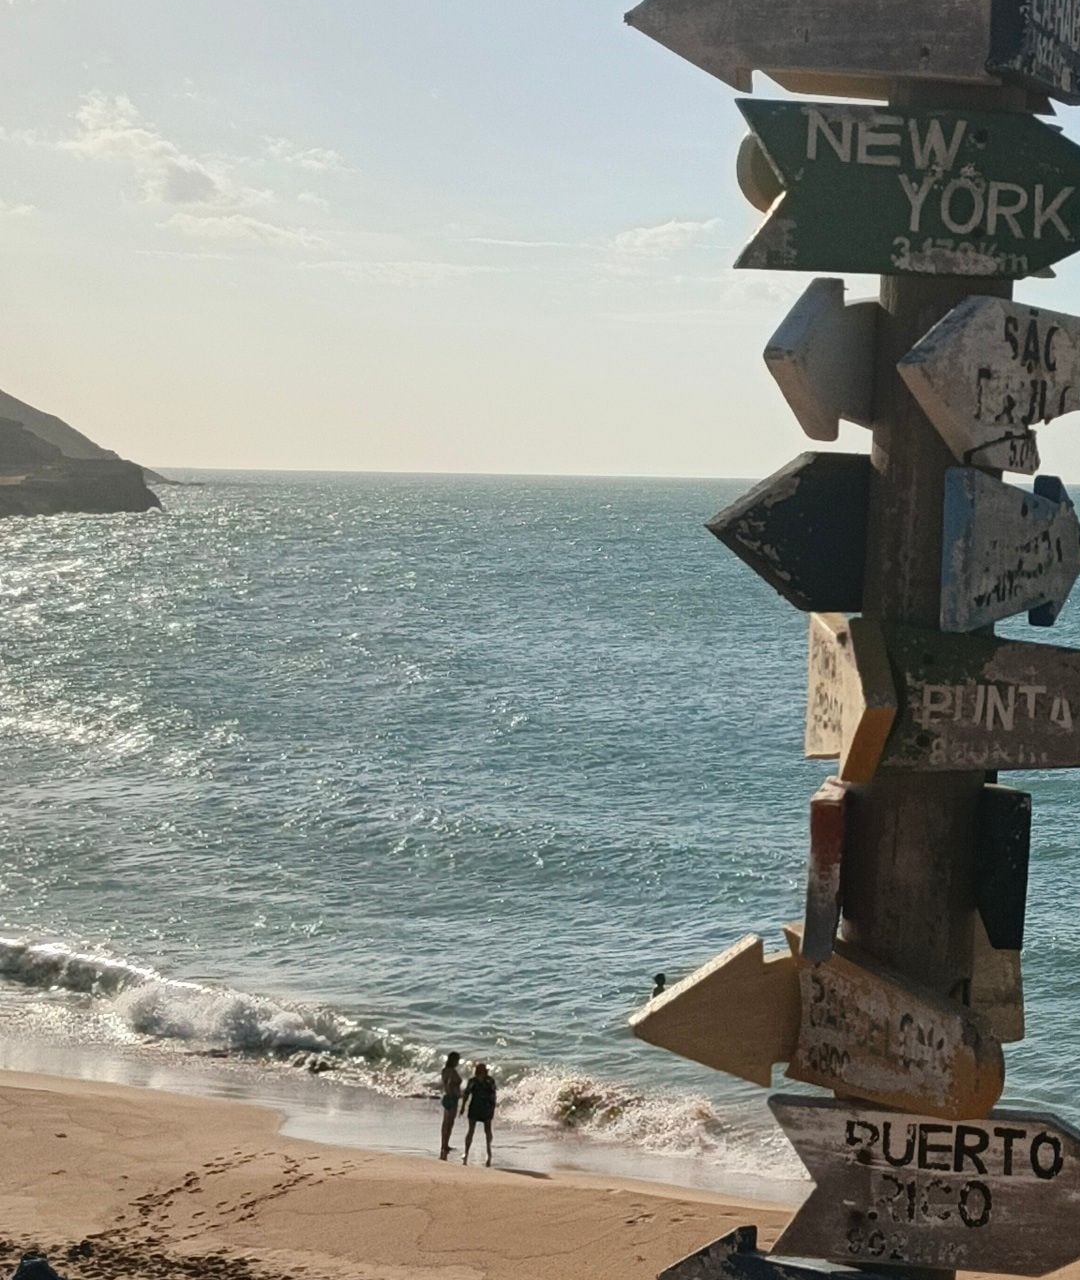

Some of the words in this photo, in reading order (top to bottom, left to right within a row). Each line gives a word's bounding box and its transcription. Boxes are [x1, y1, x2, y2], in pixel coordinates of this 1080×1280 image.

[804, 108, 967, 171] NEW
[900, 172, 1076, 241] YORK
[920, 684, 1074, 733] PUNTA
[845, 1119, 1064, 1180] PUERTO
